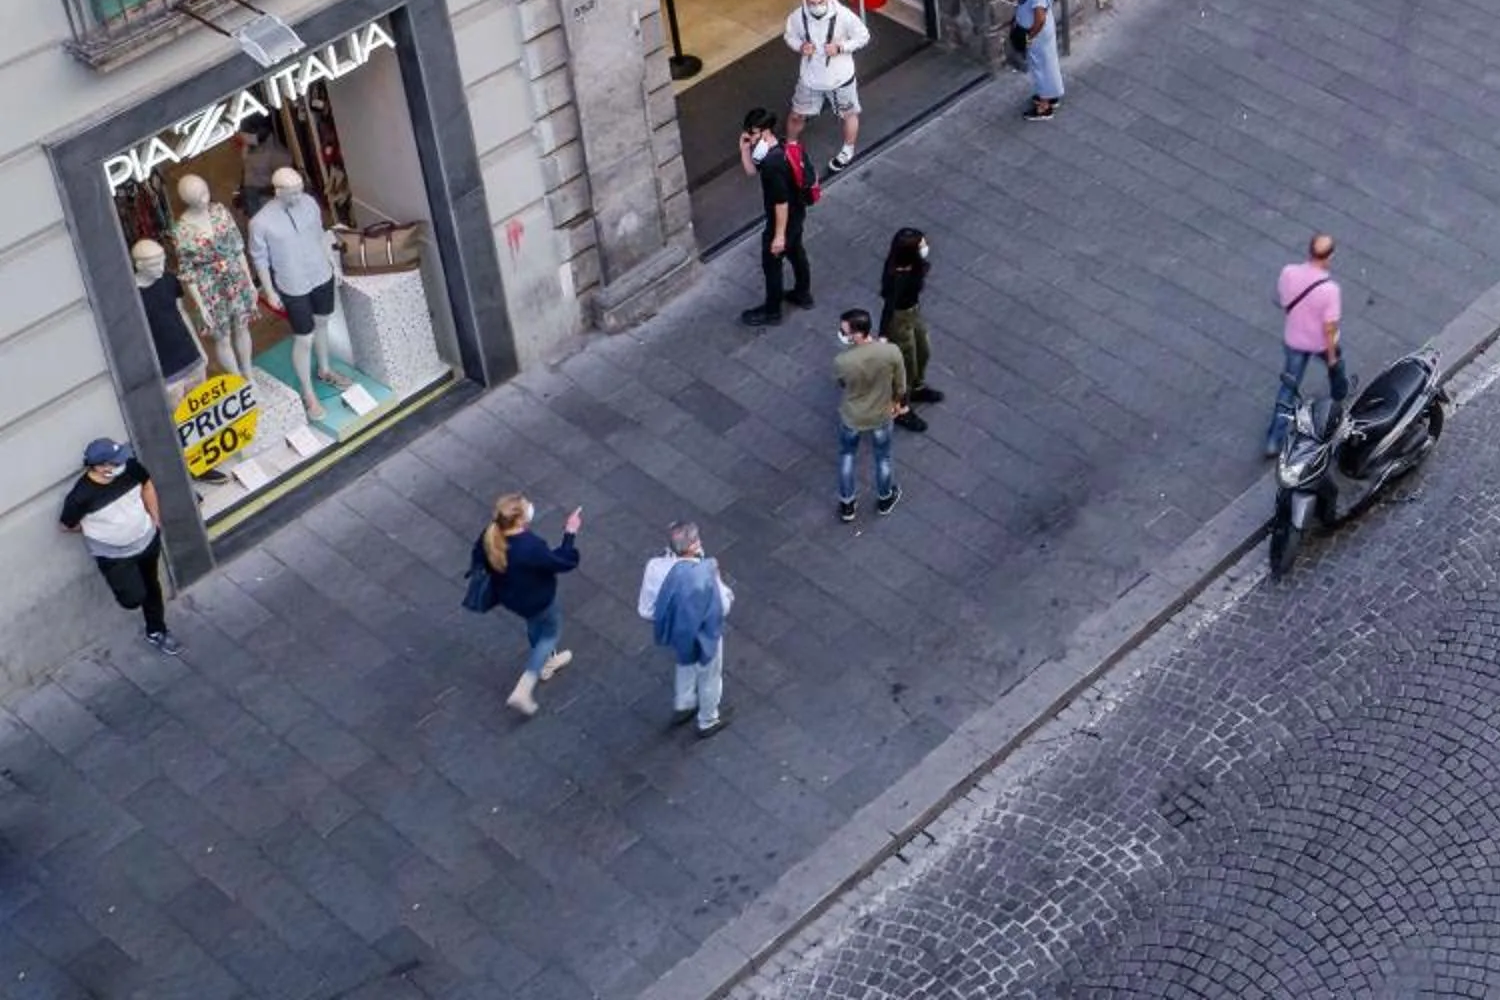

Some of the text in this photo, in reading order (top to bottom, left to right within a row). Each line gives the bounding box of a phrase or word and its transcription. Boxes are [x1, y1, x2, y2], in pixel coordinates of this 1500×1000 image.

[103, 22, 396, 196] PIAZZA ITALIA
[177, 384, 257, 448] PRICE
[187, 379, 228, 413] best
